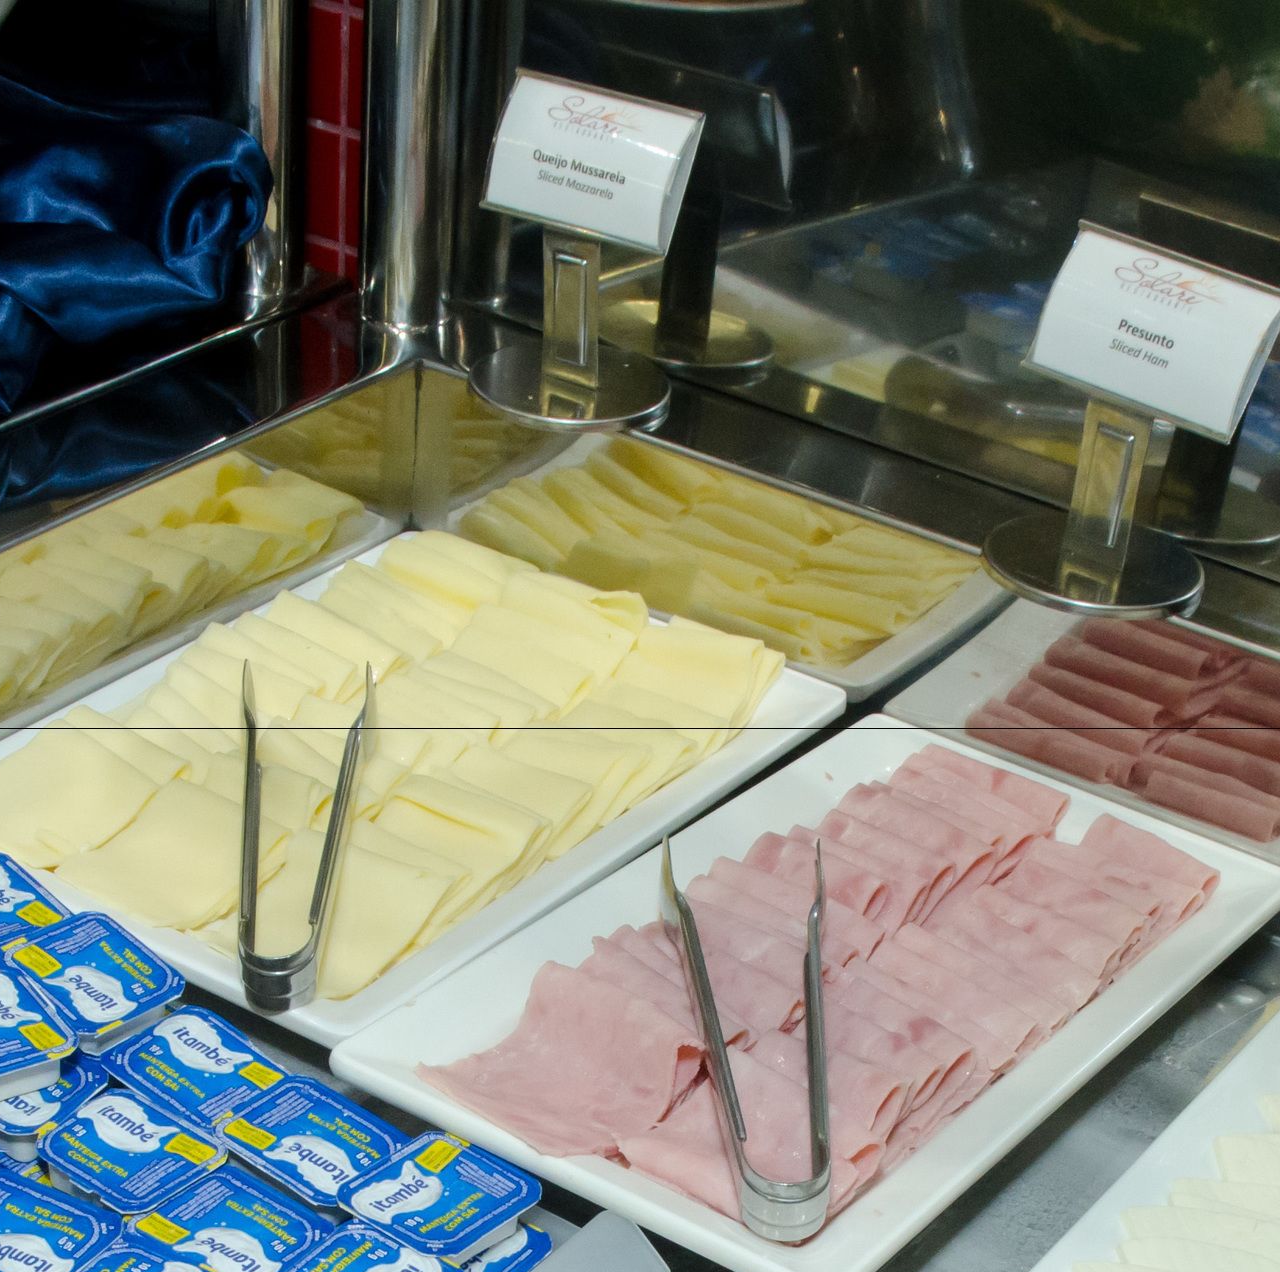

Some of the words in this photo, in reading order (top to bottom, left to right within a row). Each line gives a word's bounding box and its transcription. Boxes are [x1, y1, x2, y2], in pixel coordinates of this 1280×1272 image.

[533, 149, 568, 168] Queijo
[570, 159, 626, 185] Mussarela
[538, 170, 564, 186] Sliced
[566, 180, 613, 199] Mozzarela
[1118, 319, 1174, 349] Presunto
[1109, 339, 1142, 358] Sliced
[1143, 350, 1169, 368] Ham
[70, 975, 117, 1012] itambé
[172, 1027, 230, 1066] itambé
[97, 1106, 155, 1143] itambé
[289, 1142, 350, 1184] itambé
[369, 1175, 429, 1212] itambé
[404, 1217, 424, 1227] 10g
[367, 1249, 388, 1260] 10g
